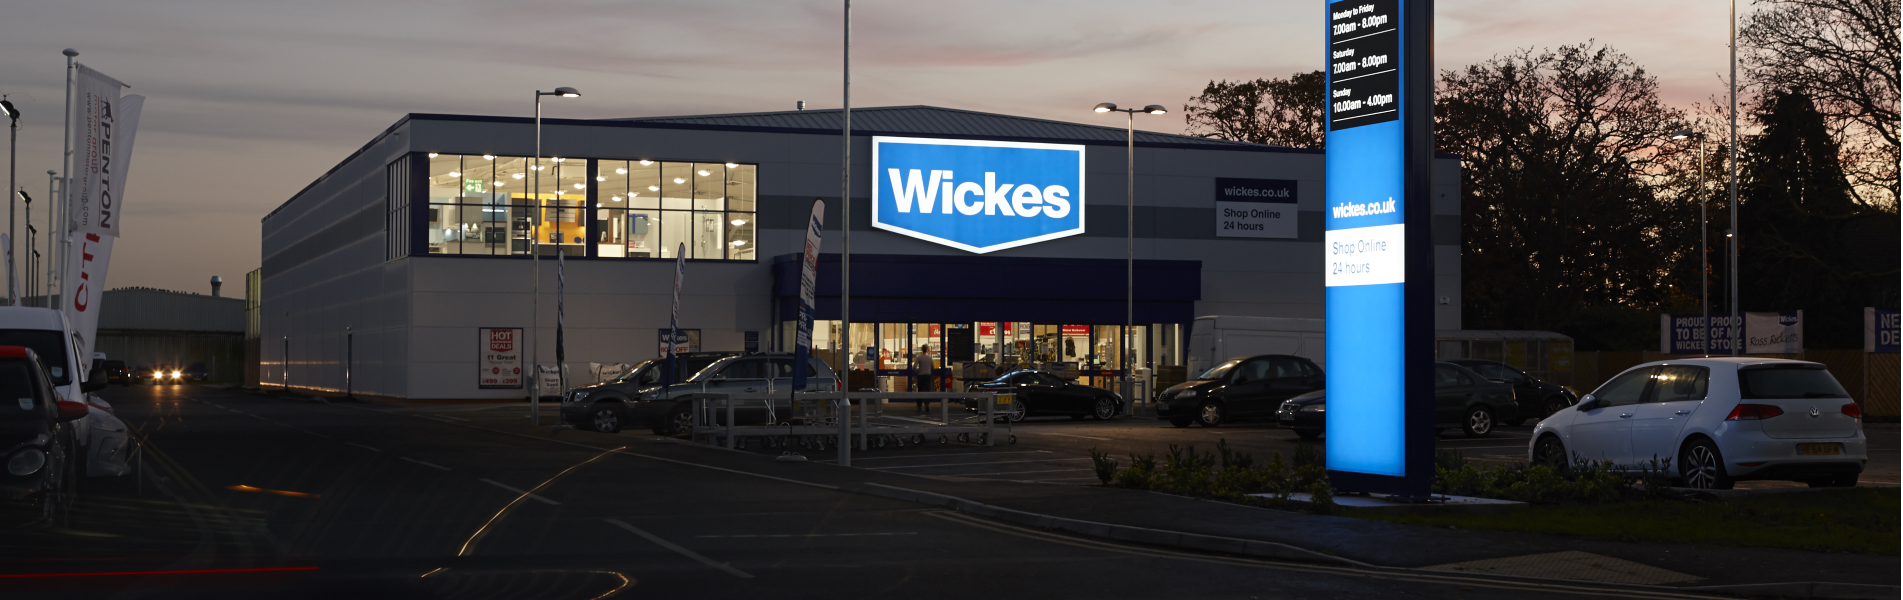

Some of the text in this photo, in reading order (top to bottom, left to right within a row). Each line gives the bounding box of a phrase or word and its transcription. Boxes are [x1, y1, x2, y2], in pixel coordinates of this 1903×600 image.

[1333, 10, 1352, 20] Monday
[1358, 4, 1374, 14] Friday
[1333, 22, 1356, 36] 7.00am
[1362, 14, 1388, 28] 8.00pm
[1333, 48, 1354, 60] Saturday
[1333, 62, 1356, 74] 7.00am
[1362, 54, 1388, 68] 8.00pm
[1333, 88, 1351, 98] Sunday
[1333, 100, 1362, 113] 10.00am
[1366, 94, 1392, 106] 4.00pm
[100, 121, 112, 229] PENTON
[888, 168, 1071, 218] Wickes
[1224, 186, 1290, 198] wickes.co.uk
[1224, 208, 1280, 220] Shop Online
[1333, 196, 1396, 218] wickes.co.uk
[1224, 221, 1264, 230] 24 hours
[1332, 239, 1386, 257] Shop Online
[1332, 261, 1370, 275] 24 hours
[1880, 314, 1901, 328] NE
[492, 332, 512, 340] HOT
[1676, 328, 1690, 340] TO
[1710, 327, 1724, 338] OF
[1750, 336, 1768, 346] Ross
